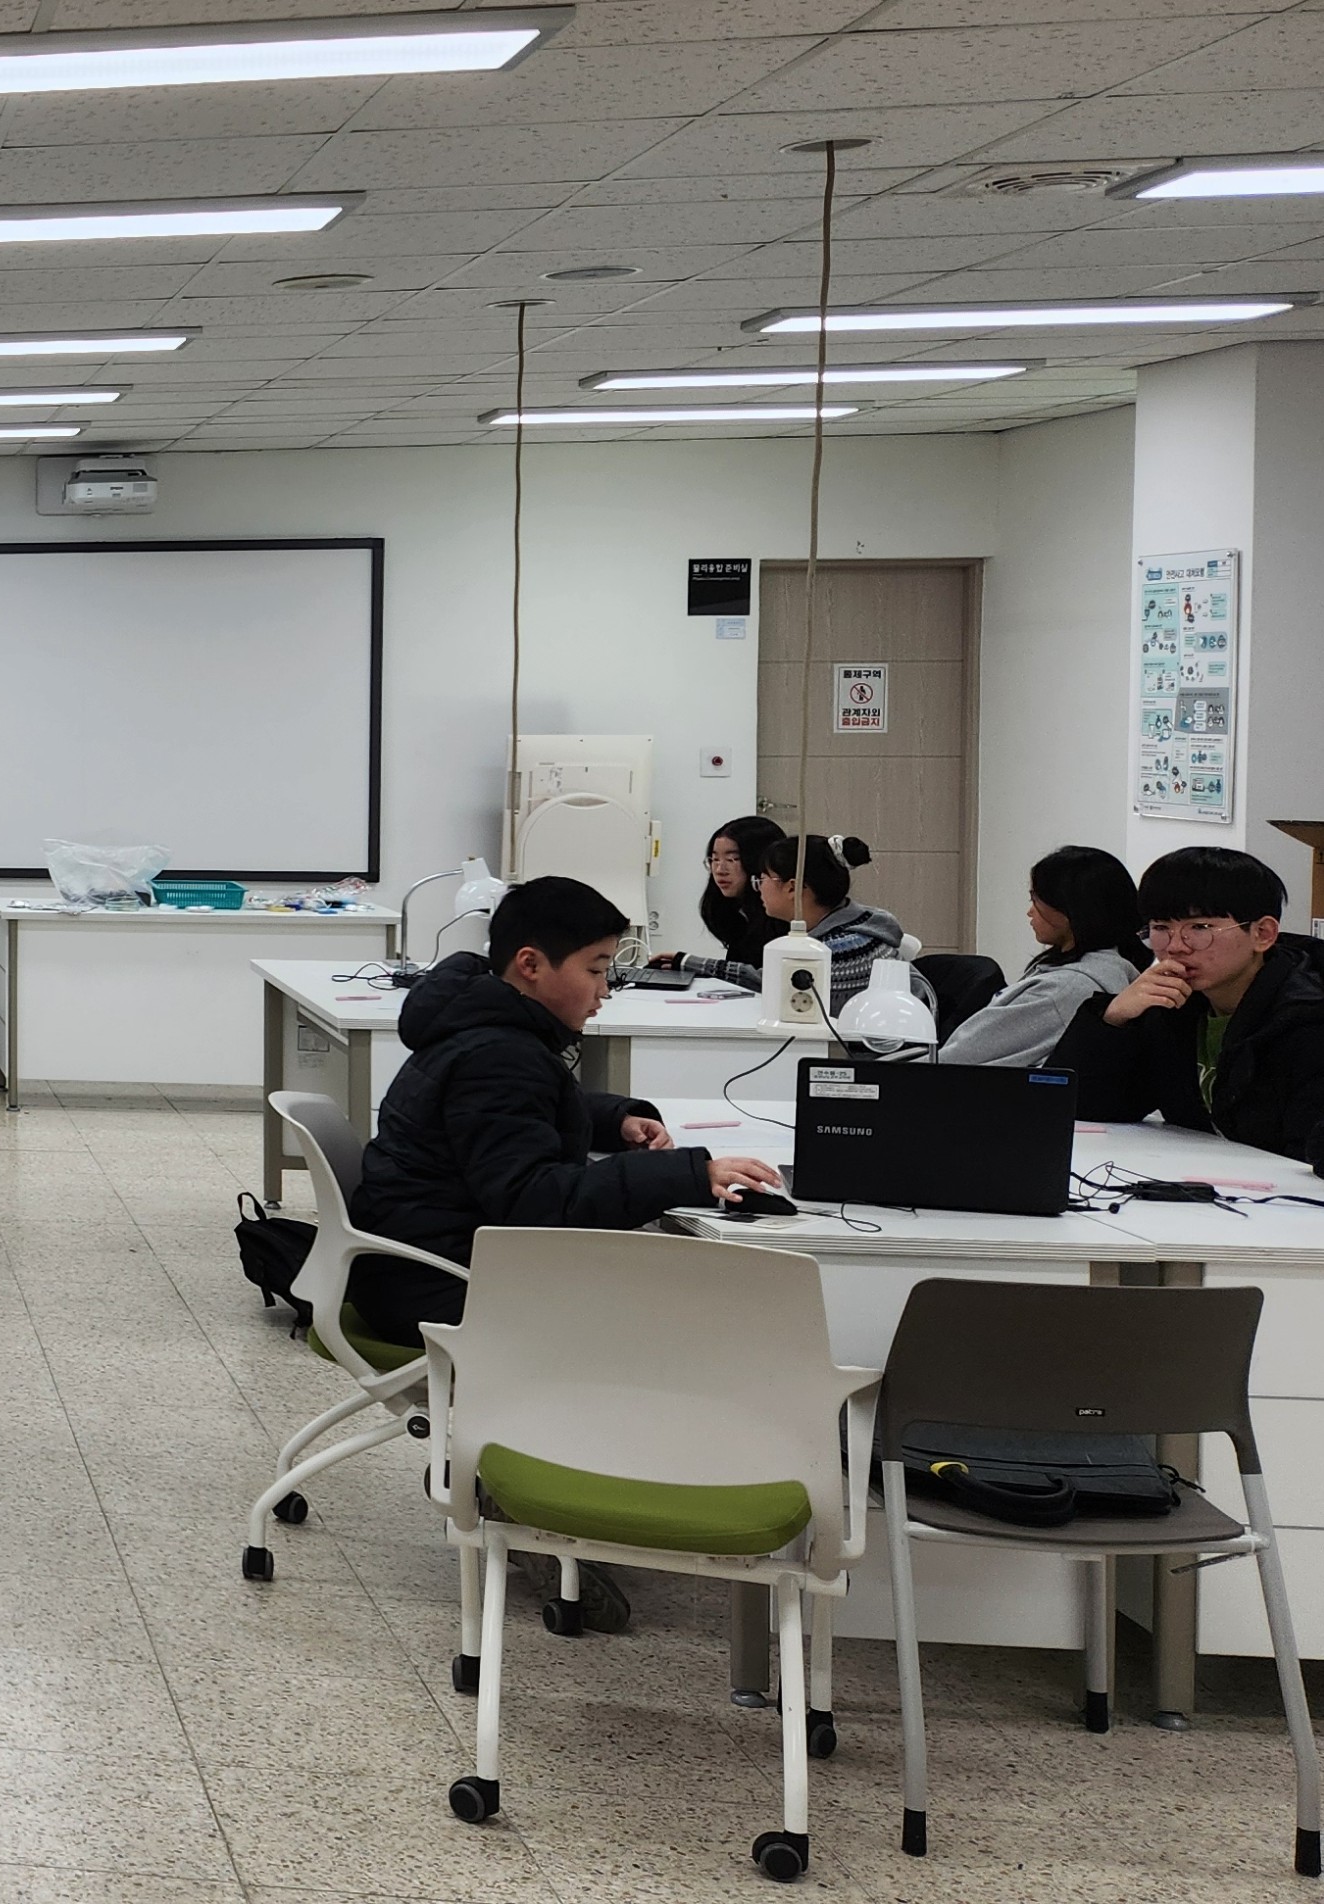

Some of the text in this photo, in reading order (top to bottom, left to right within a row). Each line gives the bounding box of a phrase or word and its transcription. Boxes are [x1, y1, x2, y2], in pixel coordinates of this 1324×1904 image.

[842, 708, 881, 717] 관계자외
[842, 717, 880, 726] 출입금지
[816, 1125, 873, 1136] SAMSUNG
